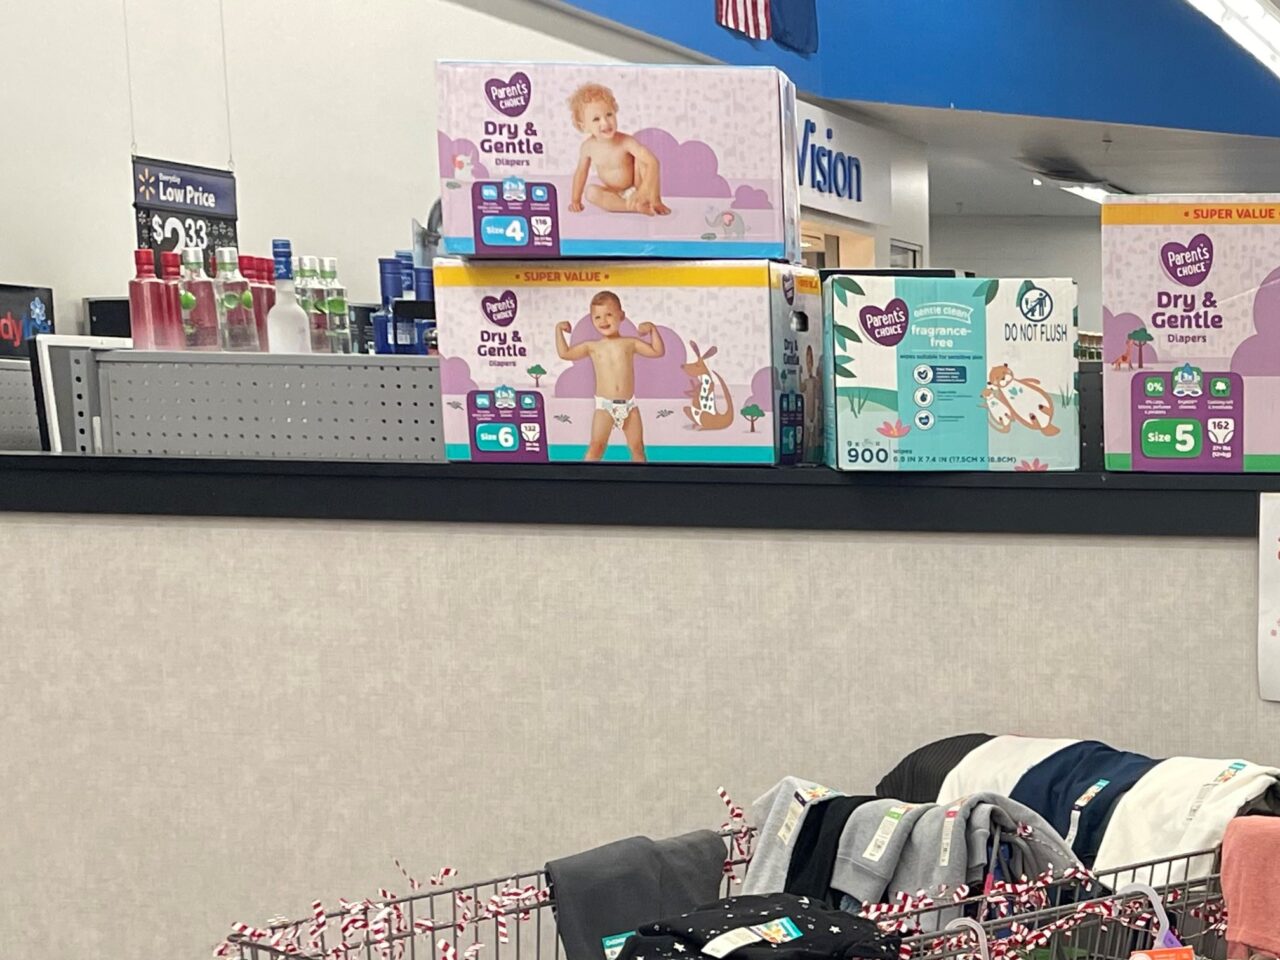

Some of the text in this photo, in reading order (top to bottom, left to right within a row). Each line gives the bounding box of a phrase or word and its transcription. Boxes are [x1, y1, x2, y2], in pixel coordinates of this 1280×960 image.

[491, 79, 528, 100] Parent's
[499, 97, 526, 109] CHOICE
[484, 121, 538, 139] Dry &
[480, 138, 543, 154] Gentle
[495, 157, 530, 167] Diapers
[797, 119, 862, 202] Vision
[159, 182, 216, 207] Low Price
[1193, 208, 1275, 219] SUPER VALUE
[486, 225, 504, 235] Size
[505, 220, 525, 242] 4
[1167, 244, 1210, 267] Parent's
[524, 272, 600, 282] SUPER VALUE
[1177, 262, 1207, 277] CHOICE
[486, 298, 515, 314] Parent's
[1157, 291, 1218, 312] Dry &
[866, 307, 906, 329] Parent's
[1151, 311, 1223, 330] Gentle
[480, 331, 522, 345] Dry &
[874, 324, 902, 338] CHOICE
[1005, 323, 1068, 342] DO NOT FLUSH
[1167, 333, 1207, 345] Diapers
[930, 337, 954, 348] free
[477, 345, 527, 357] Gentle
[1147, 383, 1163, 391] 0%
[1212, 421, 1230, 430] 162
[480, 433, 497, 441] Size
[498, 427, 514, 447] 6
[1147, 424, 1195, 452] Size 5
[848, 447, 889, 463] 900
[893, 448, 912, 457] wipes
